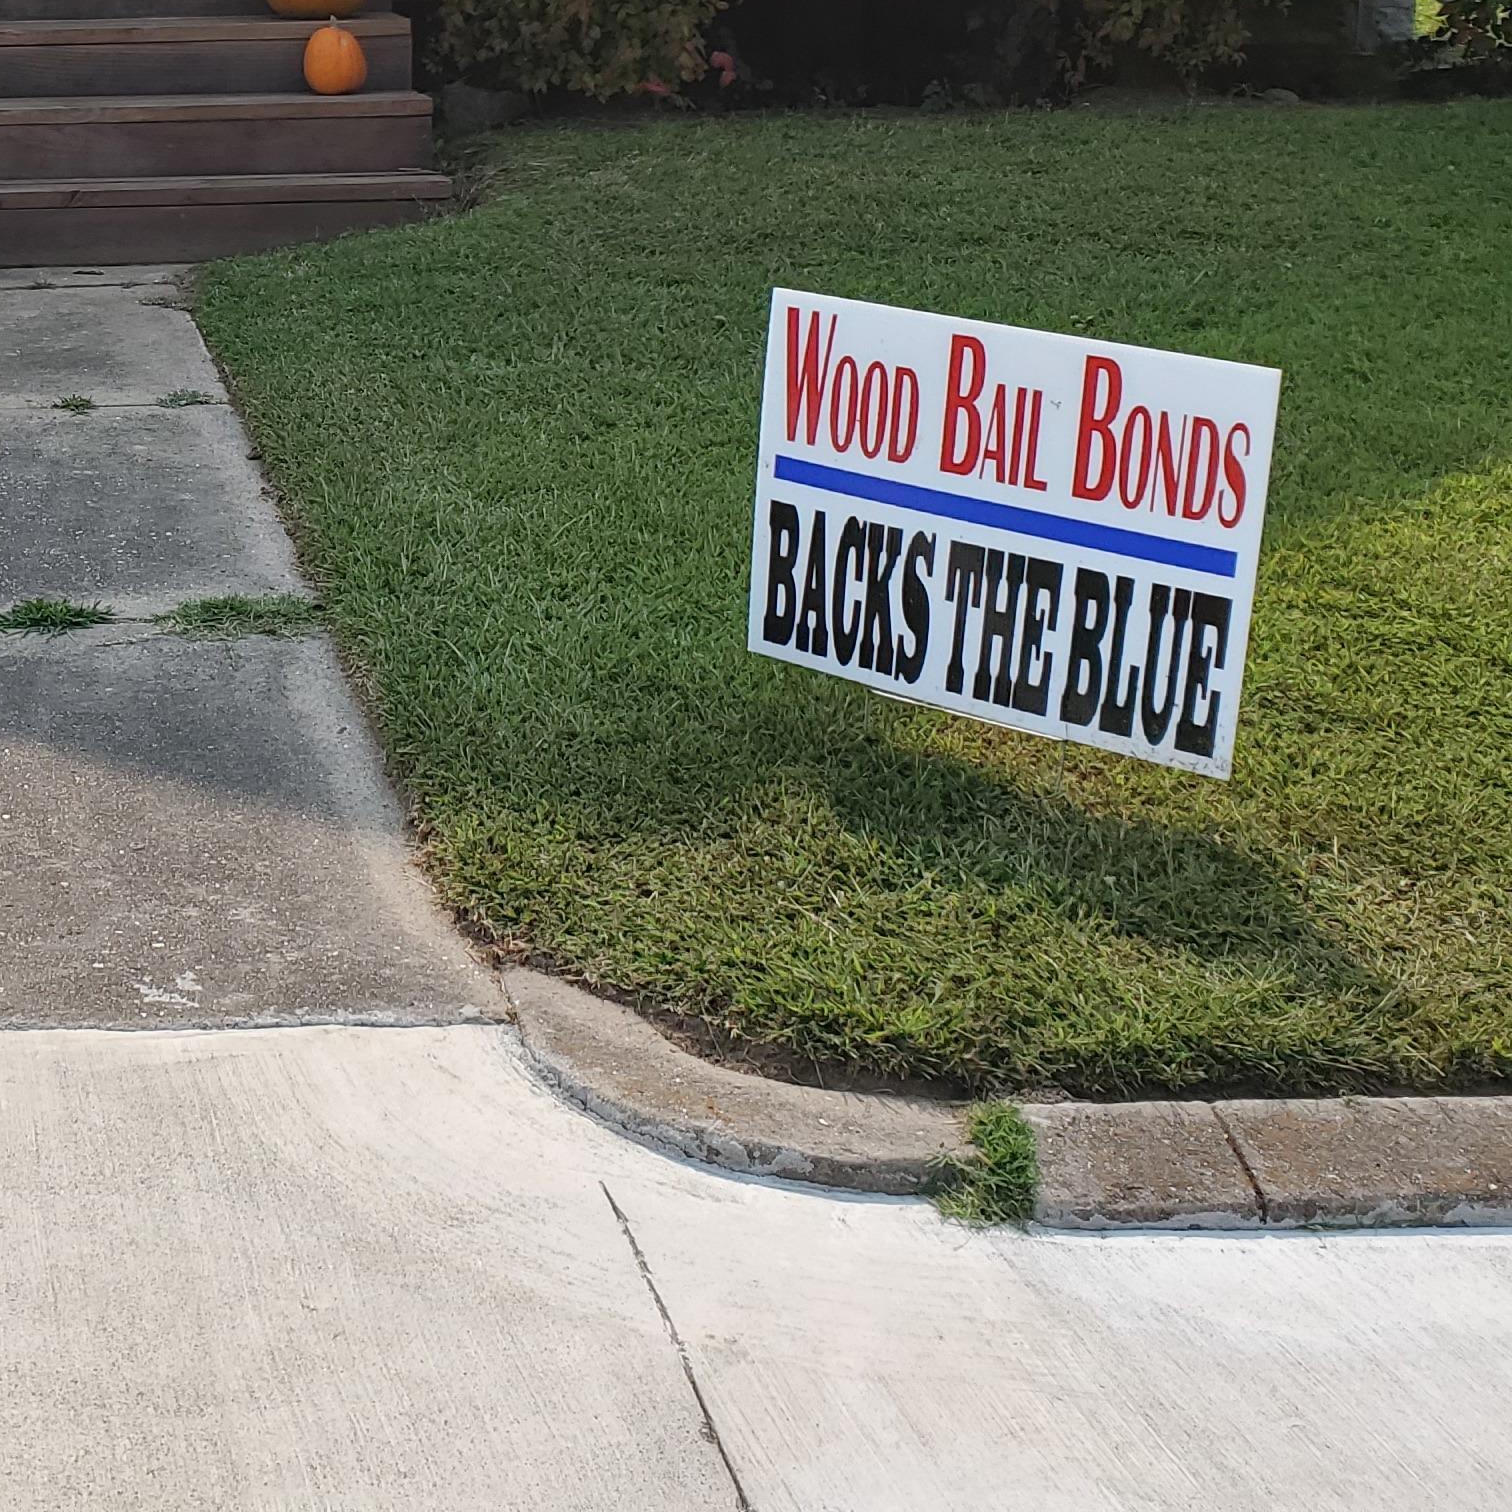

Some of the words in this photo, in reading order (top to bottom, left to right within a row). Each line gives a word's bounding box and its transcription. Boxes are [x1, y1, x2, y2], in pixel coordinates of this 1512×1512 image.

[763, 499, 937, 684] BACKS
[944, 540, 1065, 717] THE
[1059, 567, 1234, 759] BLUE
